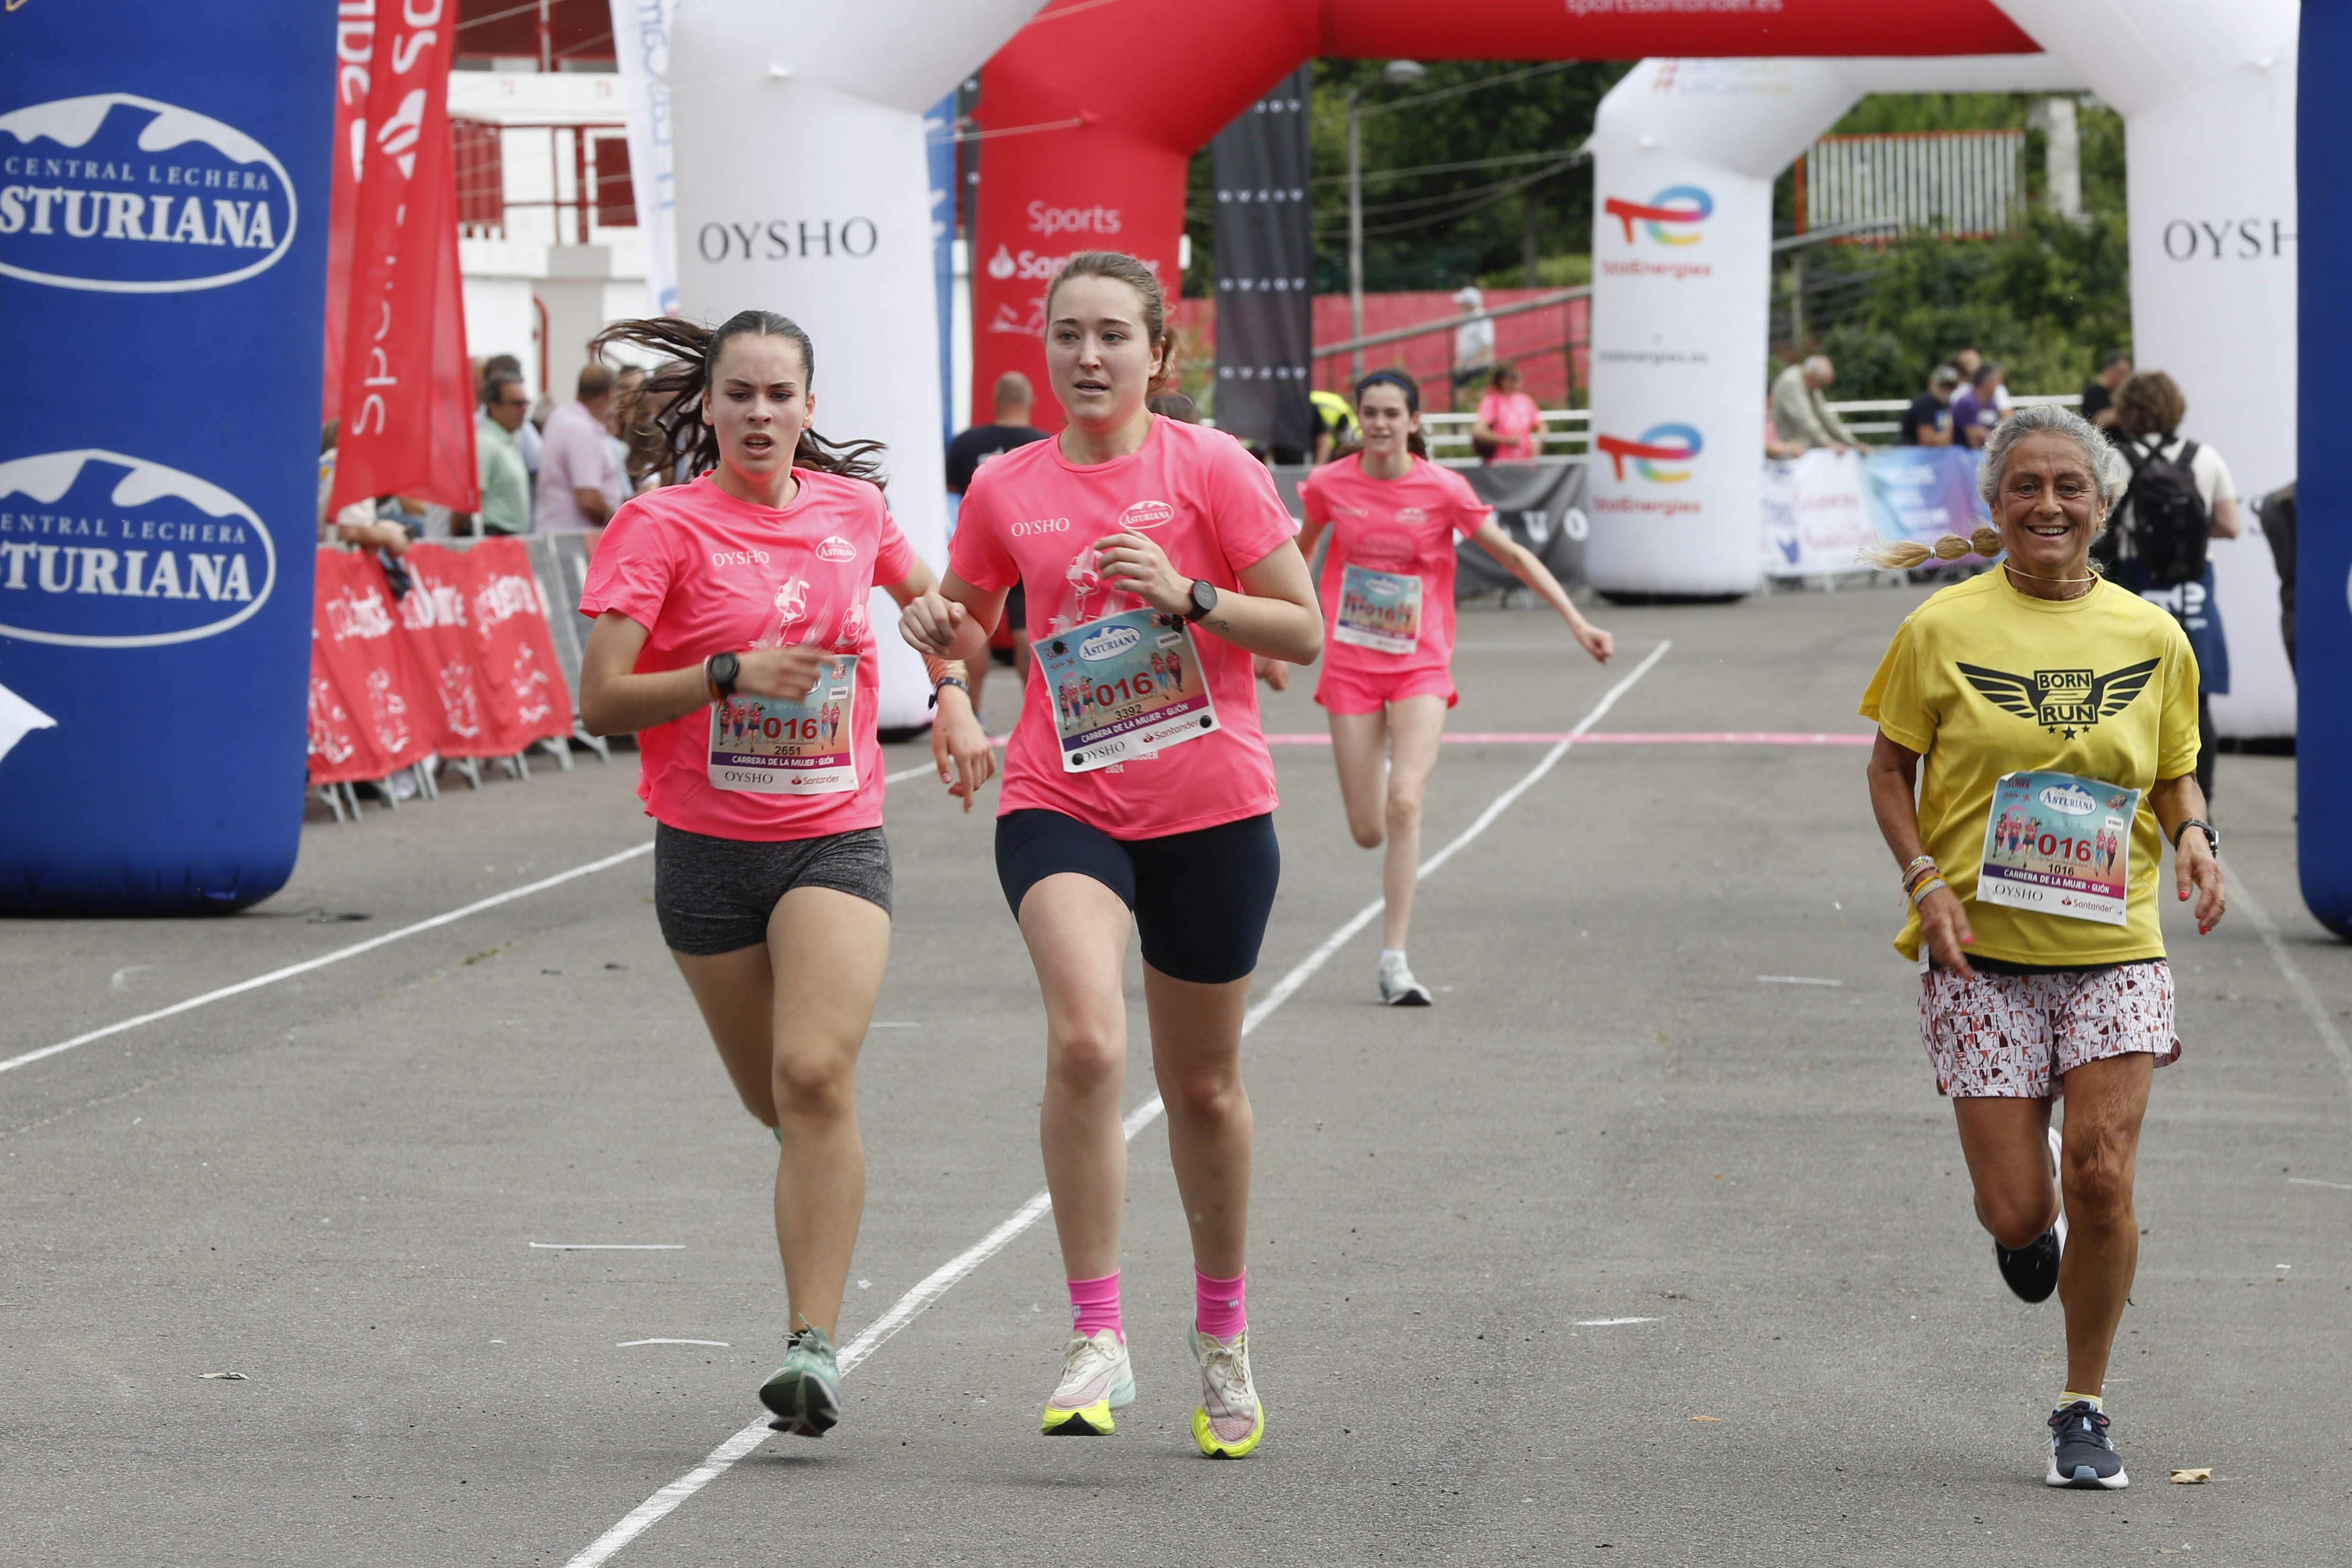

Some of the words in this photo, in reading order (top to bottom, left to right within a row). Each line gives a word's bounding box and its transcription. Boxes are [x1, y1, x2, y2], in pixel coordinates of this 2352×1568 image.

[5, 156, 135, 182] CENTRAL
[149, 165, 269, 191] LECHERA
[1027, 200, 1121, 238] Sports
[699, 216, 877, 263] OYSHO
[123, 521, 246, 544] LECHERA
[1011, 518, 1070, 537] OYSHO
[712, 550, 769, 567] OYSHO
[1, 540, 253, 602] TURIANA
[1084, 635, 1138, 657] ASTURIANA
[1096, 672, 1153, 707] 016
[2039, 673, 2090, 689] BORN
[1115, 704, 1143, 720] 3392
[2043, 705, 2094, 721] RUN
[763, 717, 817, 740] 016
[1081, 727, 1112, 743] CARRERA
[1115, 724, 1124, 734] DE
[1126, 720, 1135, 730] LA
[1136, 712, 1162, 726] MUJER
[1154, 719, 1199, 741] Santander
[732, 755, 766, 765] CARRERA
[768, 756, 778, 766] DE
[780, 757, 789, 766] LA
[791, 757, 815, 767] MUJER
[774, 746, 801, 756] 2651
[725, 771, 773, 784] OYSHO
[803, 775, 840, 785] Santander
[2043, 791, 2093, 811] ASTURIANA
[2038, 833, 2092, 861] 016
[2004, 869, 2038, 883] CARRERA
[2039, 876, 2050, 884] DE
[2051, 877, 2061, 886] LA
[2063, 879, 2086, 890] MUJER
[2048, 863, 2074, 876] 1016
[1994, 883, 2043, 901] OYSHO
[2073, 899, 2114, 913] Santander
